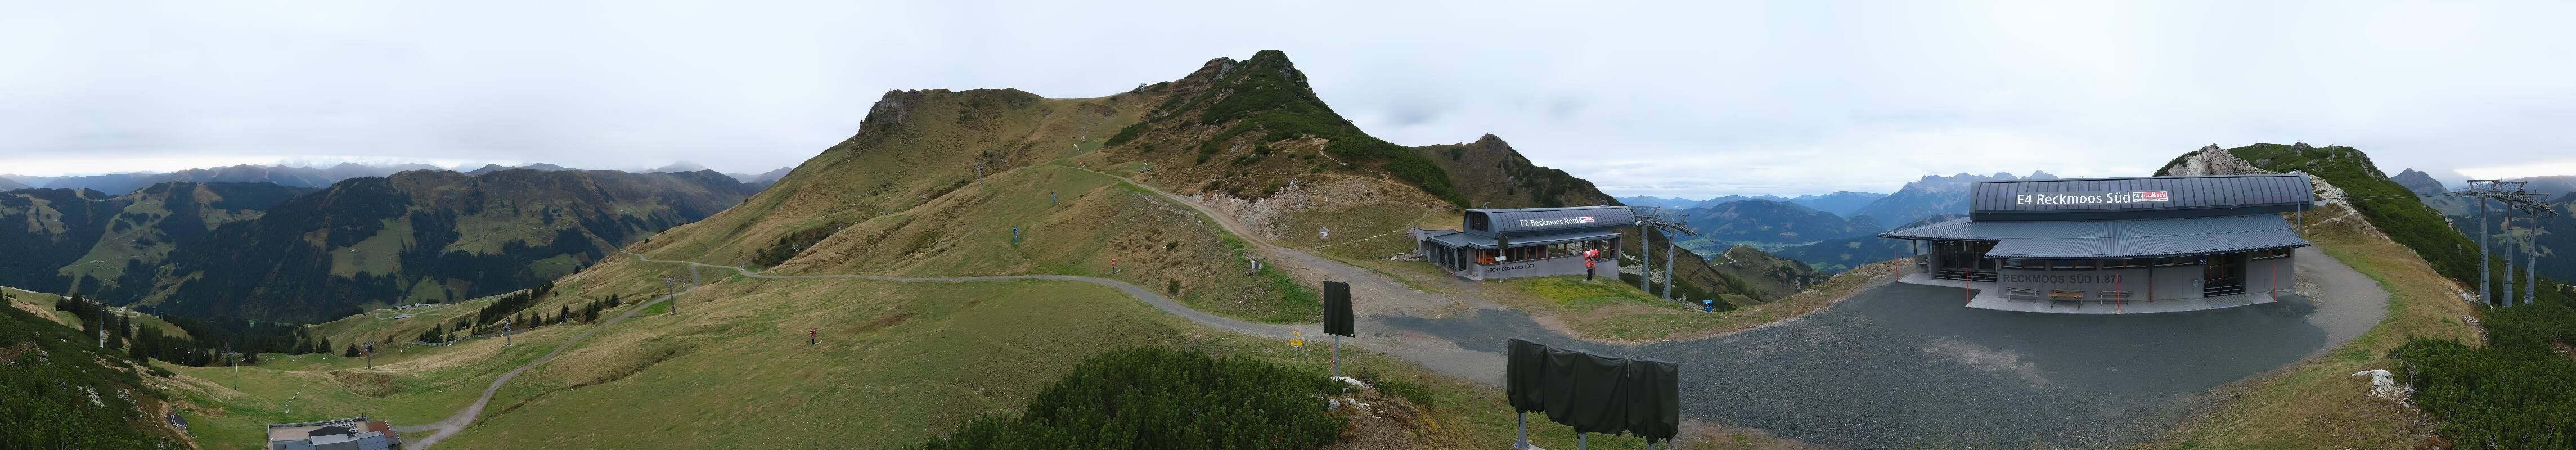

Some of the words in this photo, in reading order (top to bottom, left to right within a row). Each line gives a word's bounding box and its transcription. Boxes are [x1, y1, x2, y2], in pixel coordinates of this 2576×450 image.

[2017, 194, 2033, 205] E4
[2036, 193, 2102, 205] Reckmoos
[2107, 192, 2130, 204] Süd
[2003, 273, 2064, 284] RECKMOOS
[2070, 273, 2092, 284] SÜD
[2095, 274, 2123, 284] 1.870
